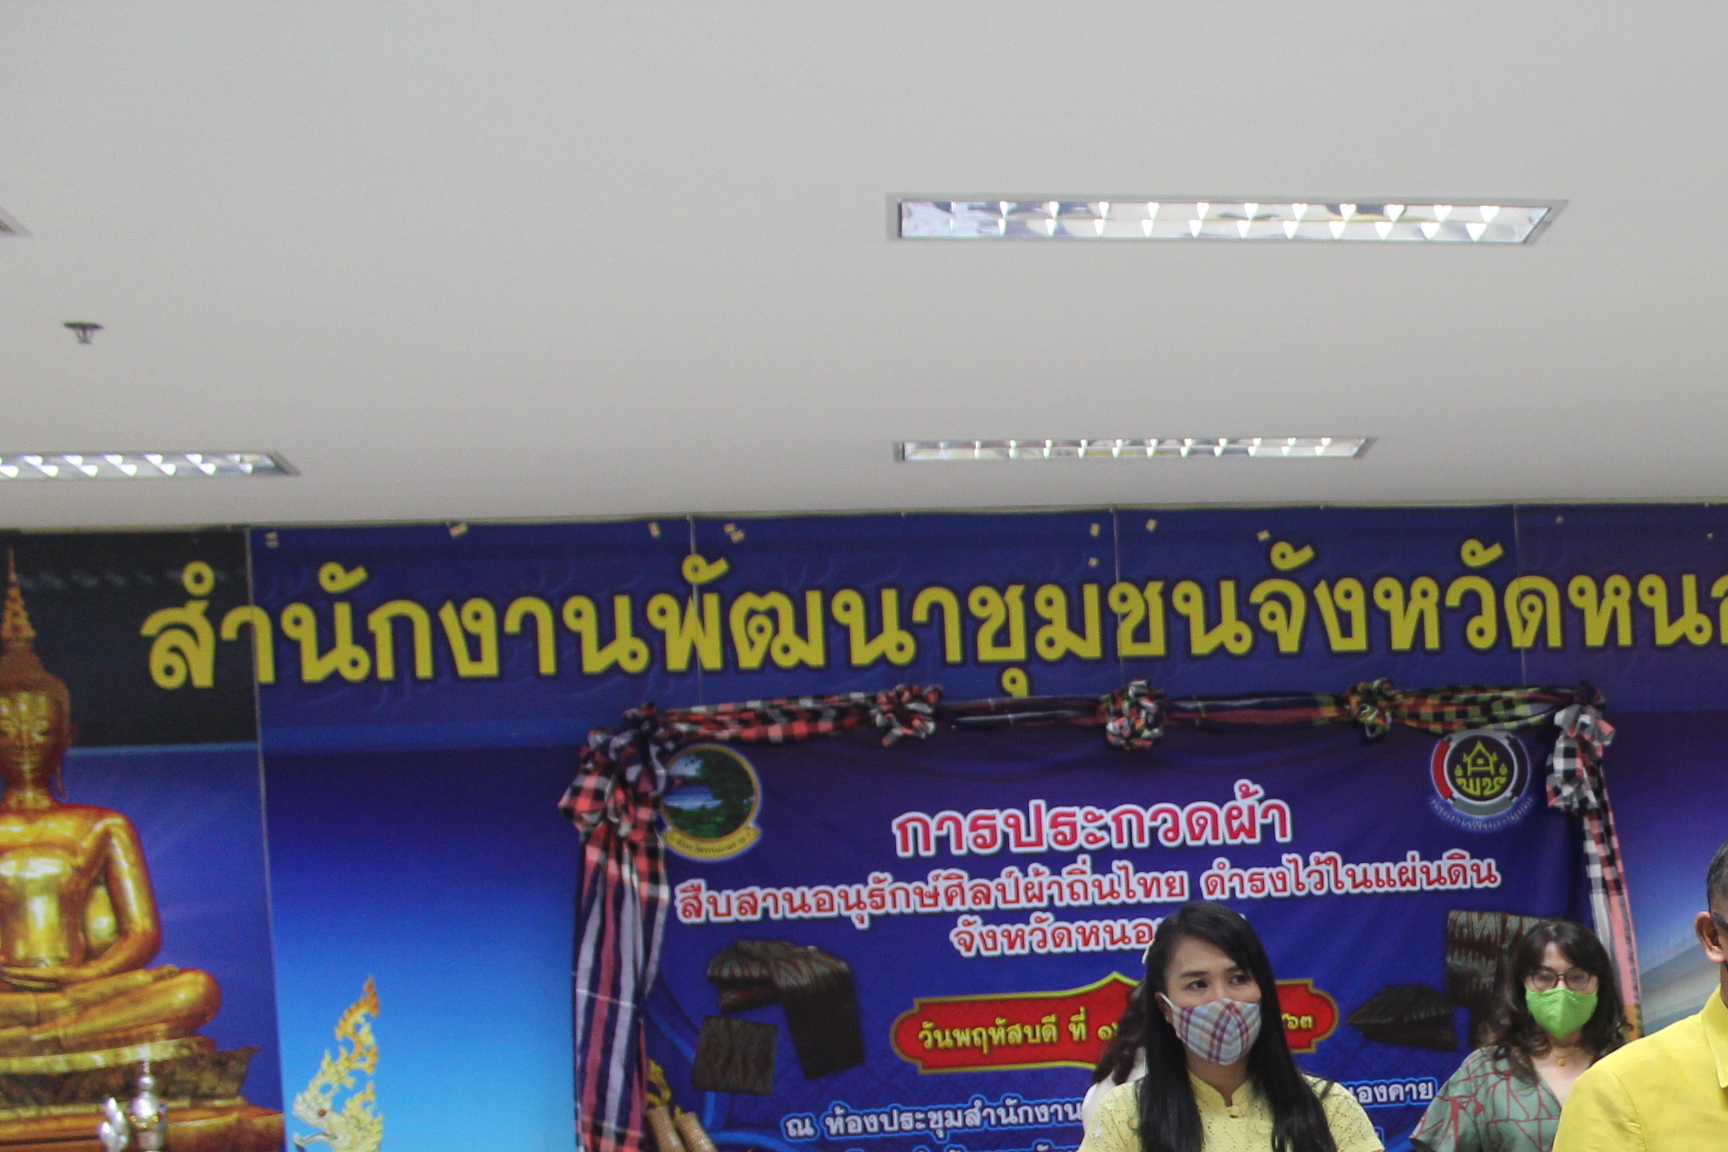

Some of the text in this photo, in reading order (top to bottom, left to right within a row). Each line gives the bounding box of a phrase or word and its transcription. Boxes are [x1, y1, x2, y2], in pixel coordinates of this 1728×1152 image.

[895, 781, 1290, 854] การประกวดผ้า
[678, 849, 1498, 926] สืบสานอนุรักษ์ศิลป์ผ้าถิ่นไทย ดำรงไว้ในแผ่นดิน
[953, 912, 1155, 956] จังหวัดหนอ
[919, 1014, 1058, 1055] วันพฤหัสบดี
[1068, 1006, 1088, 1042] ที่
[785, 1115, 815, 1138] ณ
[1351, 1080, 1434, 1104] องคาย
